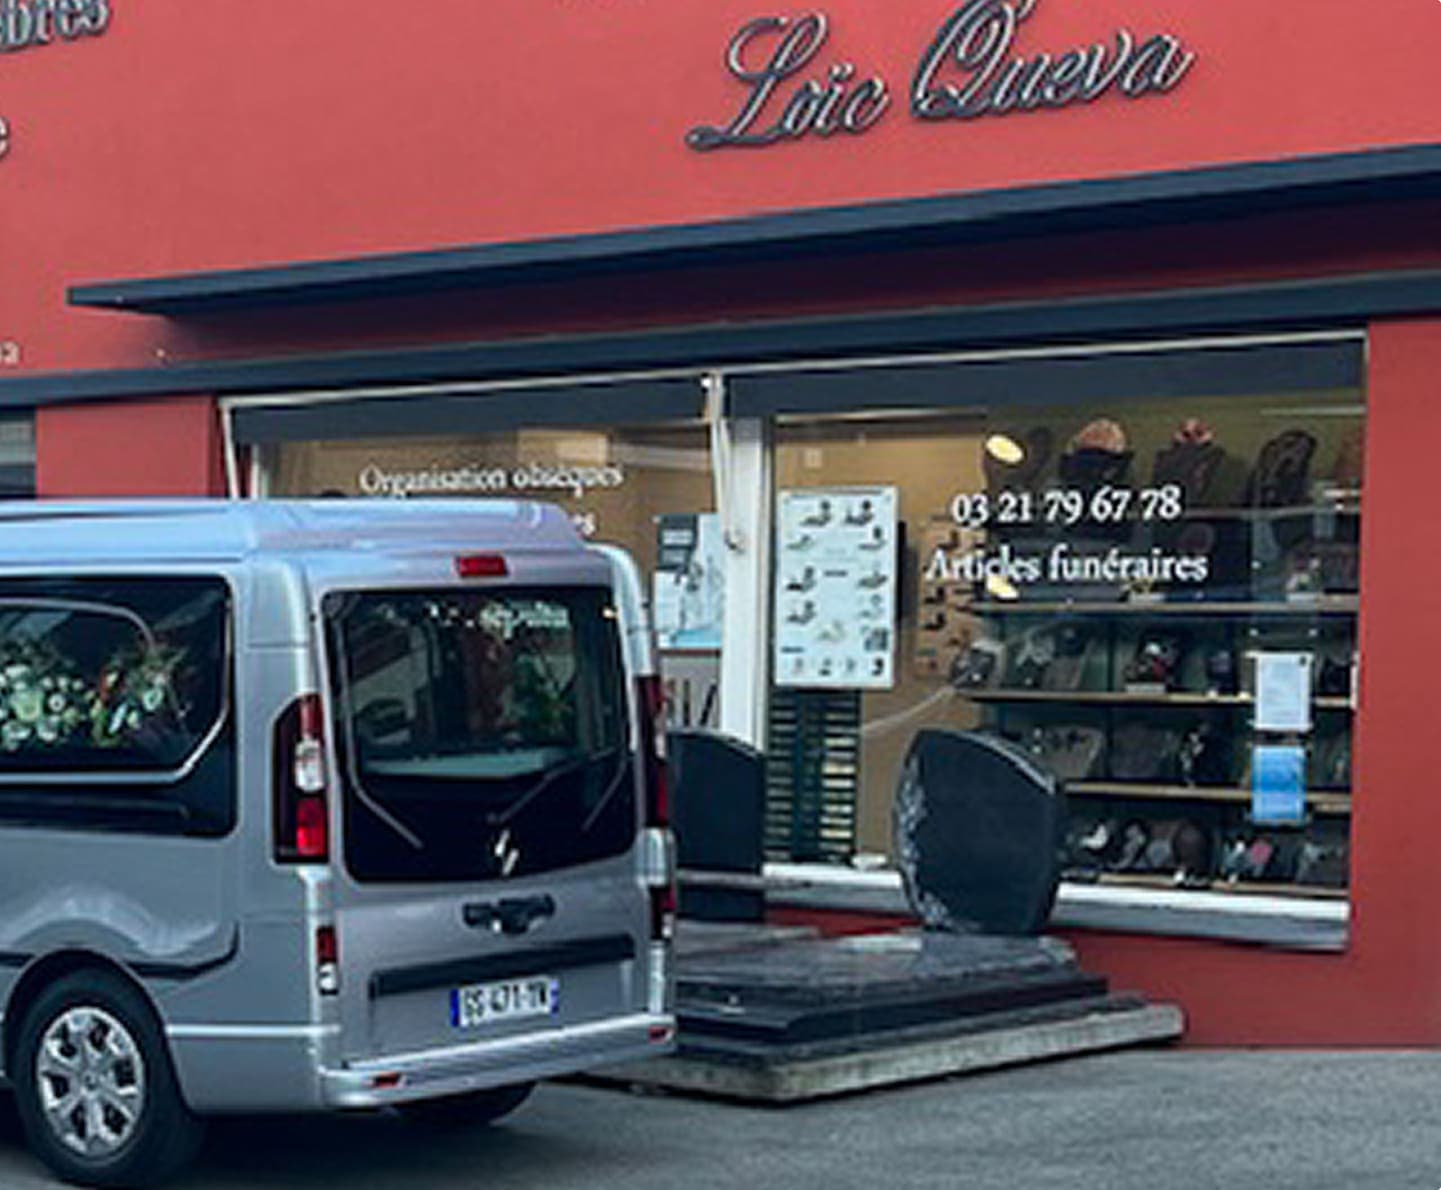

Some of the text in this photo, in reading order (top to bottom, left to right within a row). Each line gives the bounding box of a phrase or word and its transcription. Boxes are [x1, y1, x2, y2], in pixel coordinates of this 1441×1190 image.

[685, 0, 1196, 150] Loïc Queva
[360, 463, 507, 498] Organisation
[951, 484, 1182, 528] 03 21 79 67 78
[926, 543, 1210, 582] Articles funéraires
